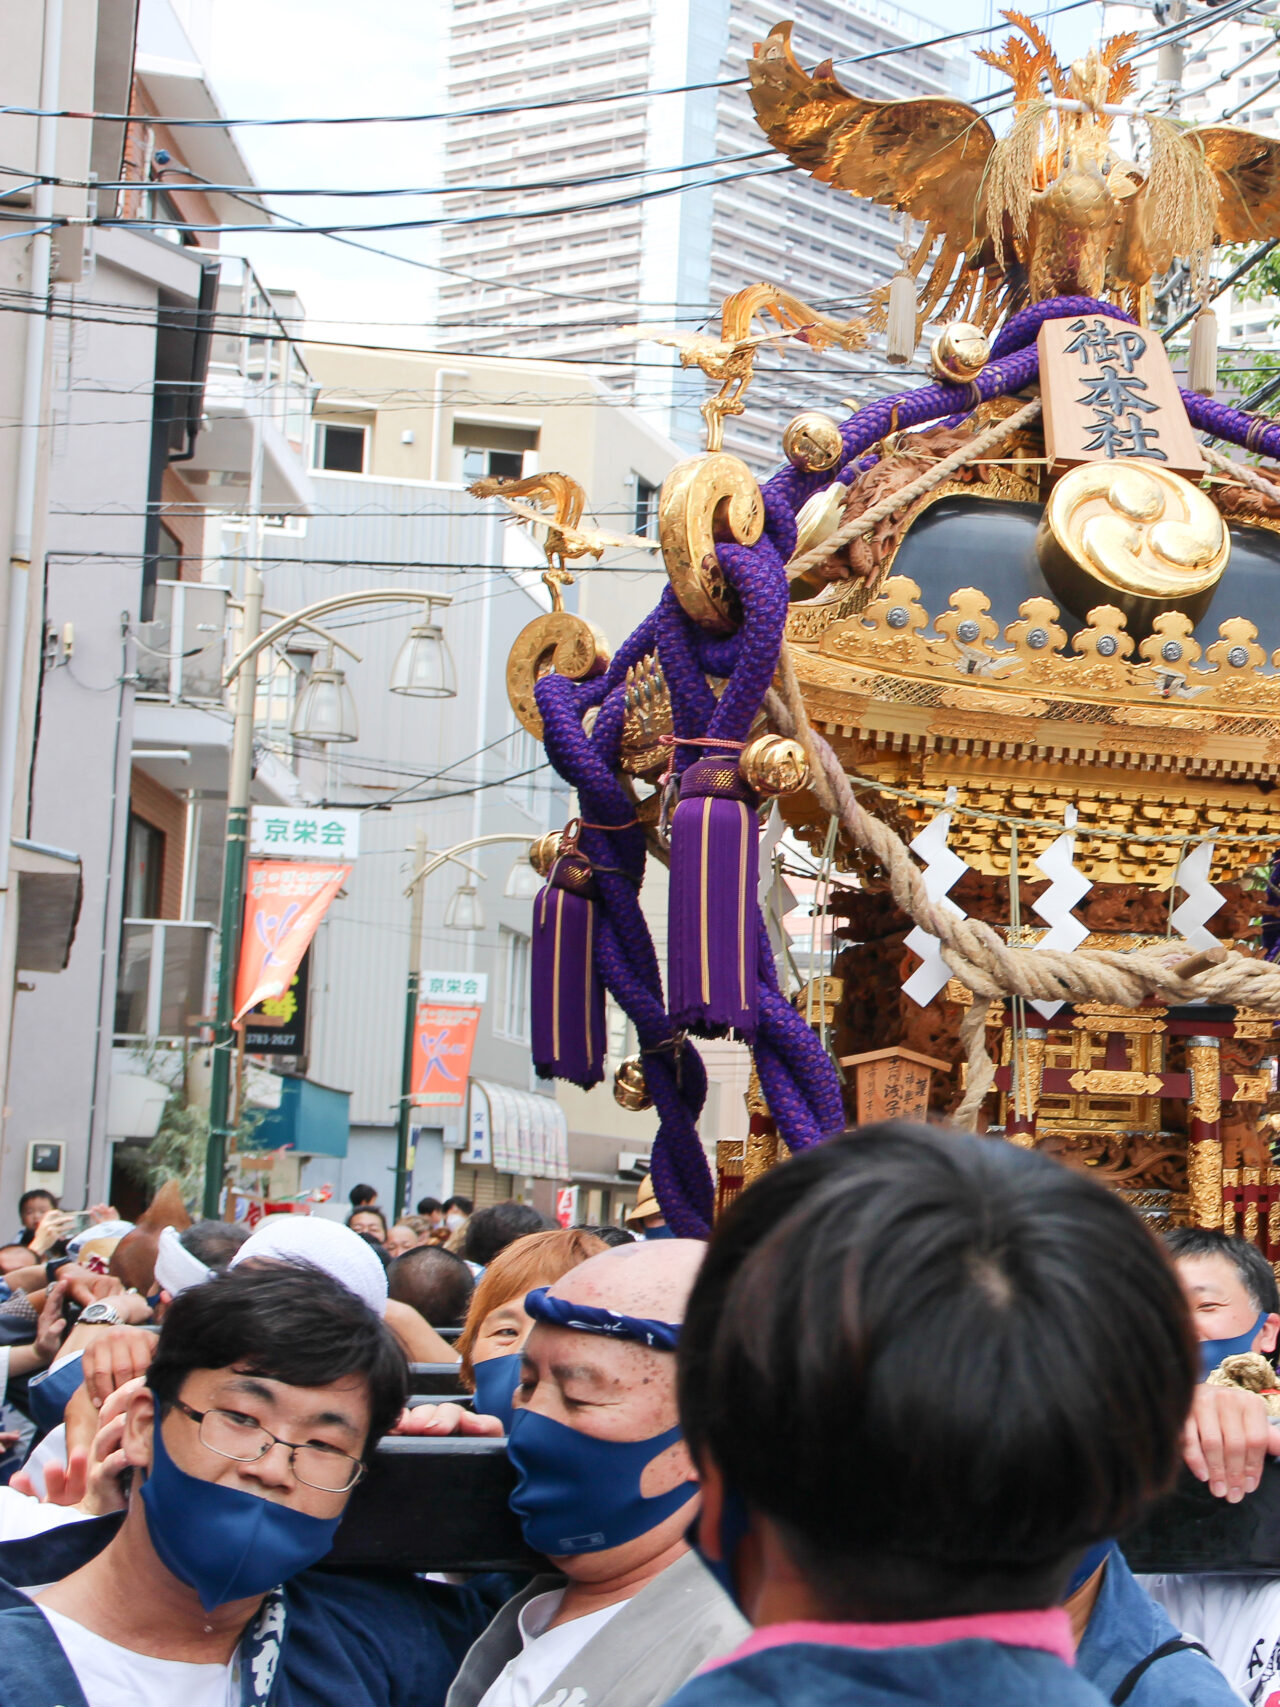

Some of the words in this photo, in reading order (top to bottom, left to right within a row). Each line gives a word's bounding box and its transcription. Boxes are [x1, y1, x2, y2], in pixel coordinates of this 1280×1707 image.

[1063, 318, 1168, 461] 御本社
[263, 818, 346, 846] 京栄会
[429, 978, 479, 994] 京栄会
